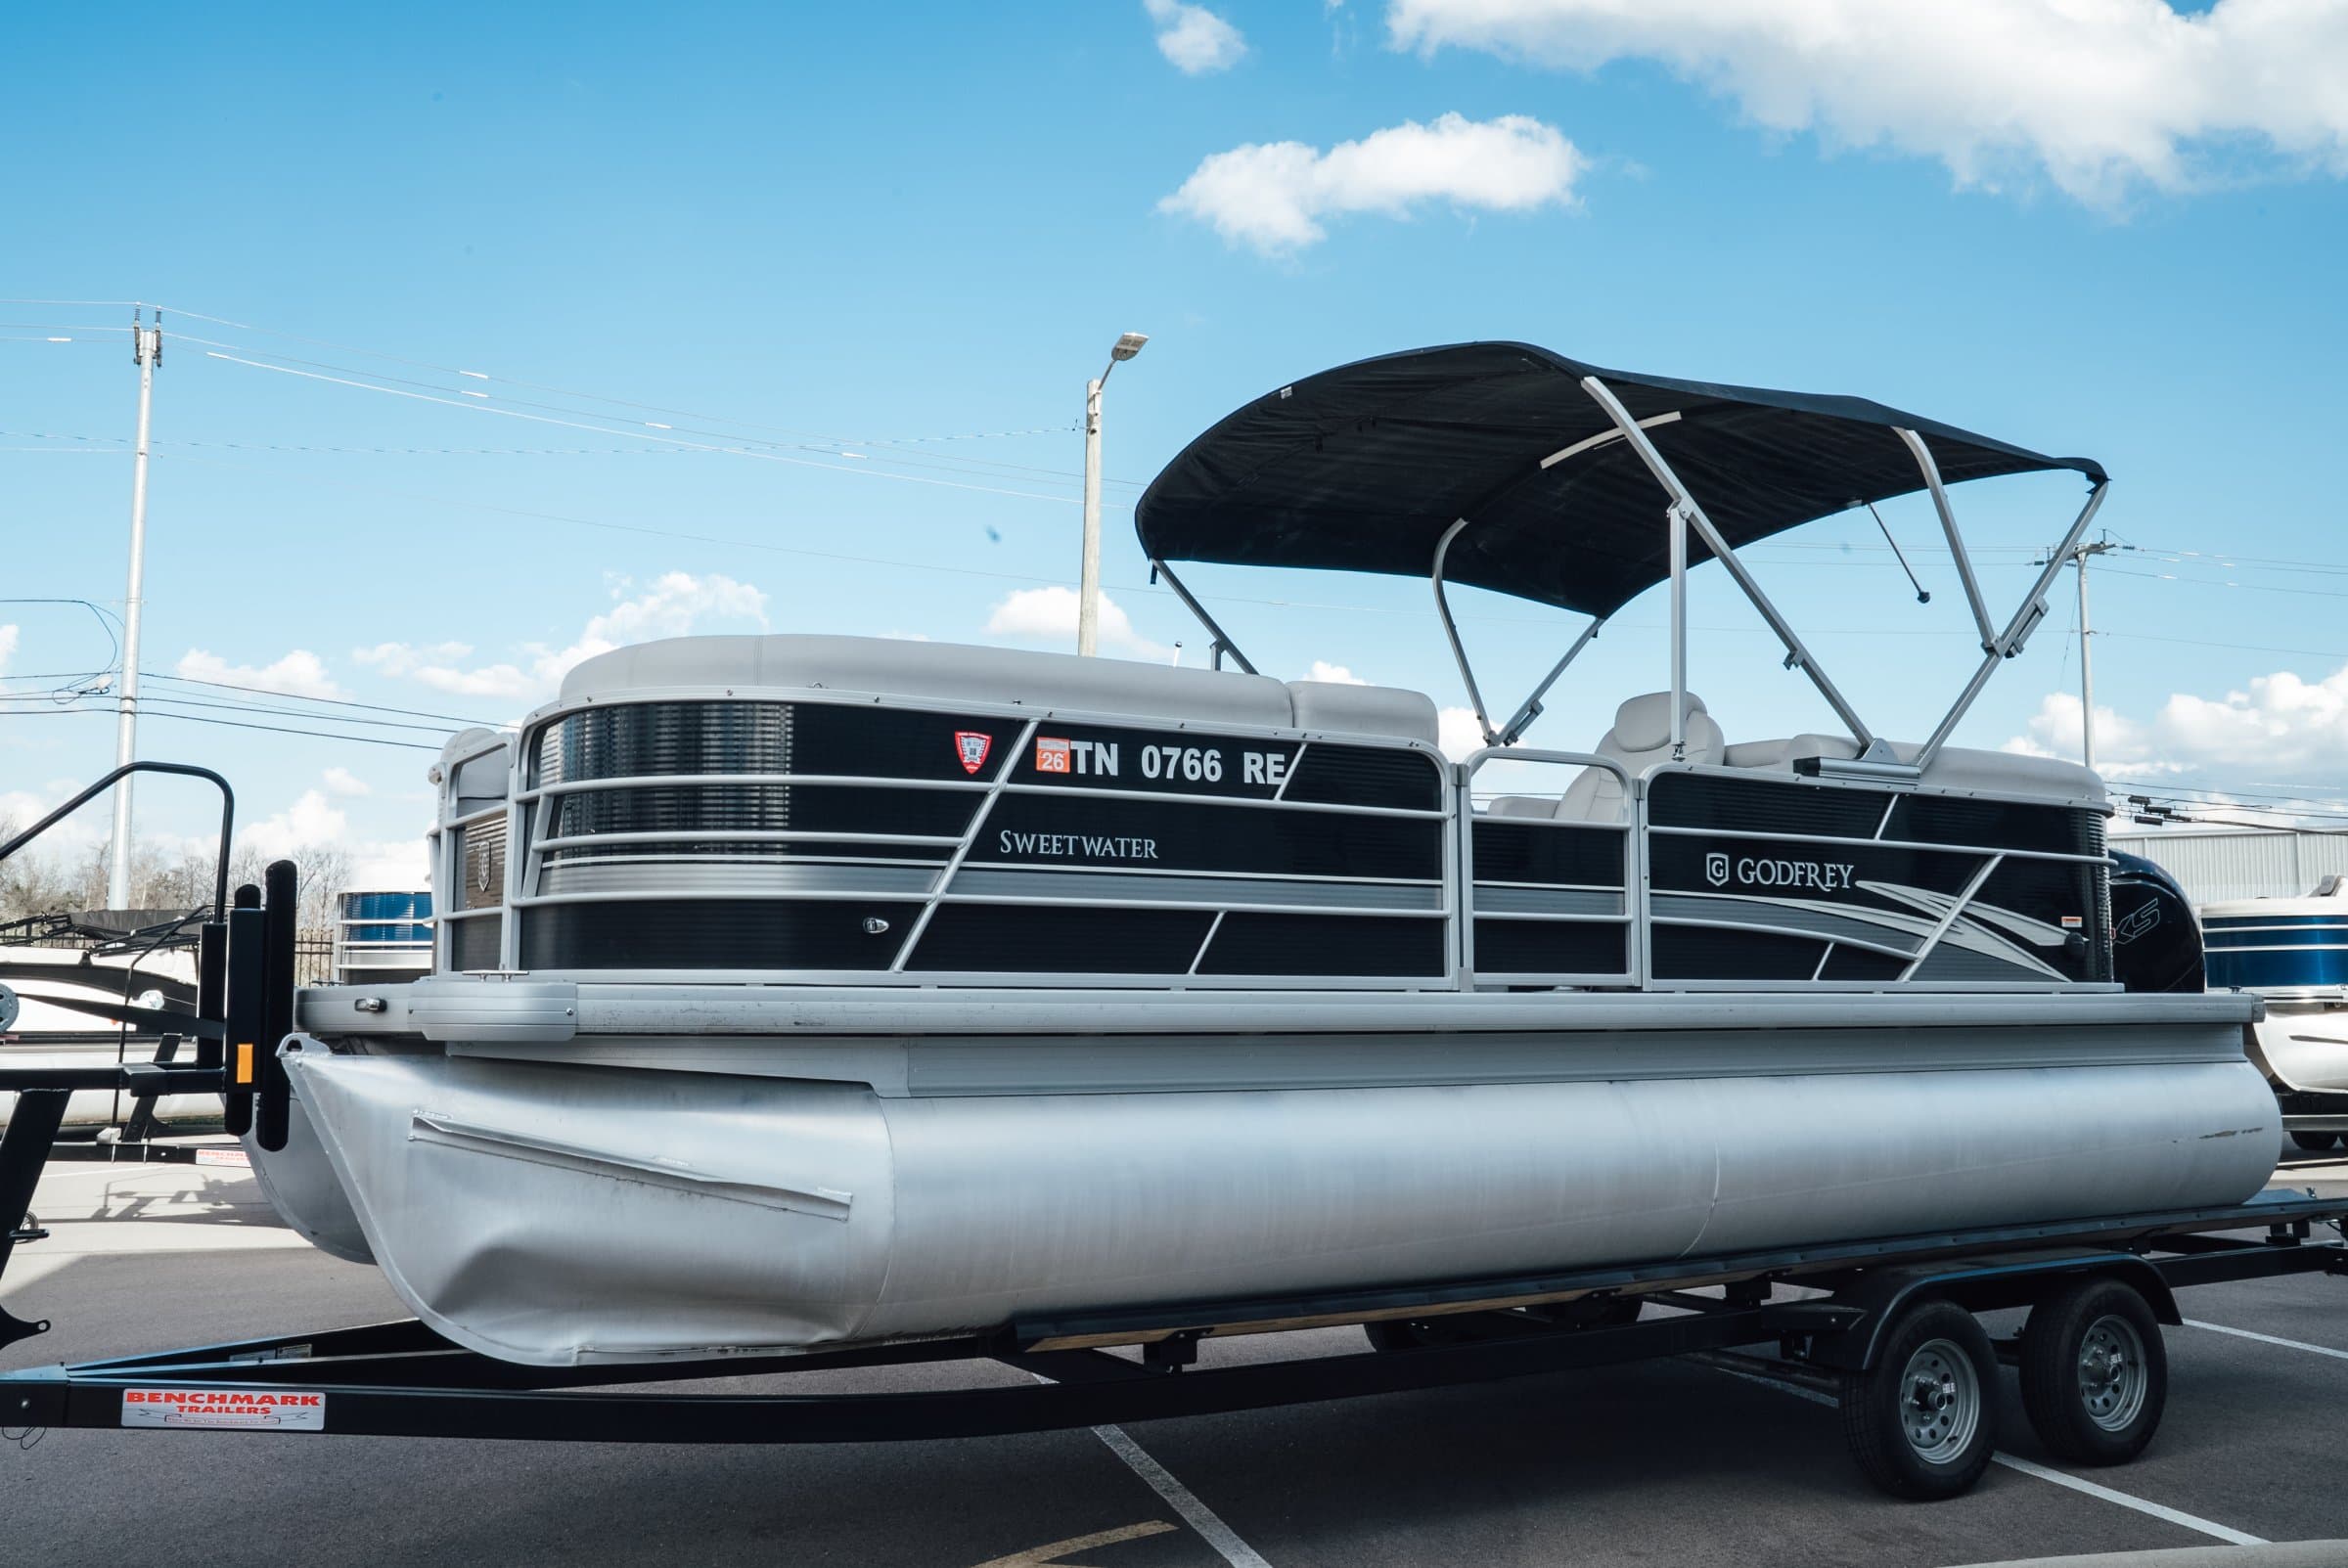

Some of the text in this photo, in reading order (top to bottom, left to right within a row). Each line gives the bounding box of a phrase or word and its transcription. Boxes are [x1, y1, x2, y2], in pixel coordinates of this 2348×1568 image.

[1040, 750, 1065, 771] 26
[1069, 740, 1286, 785] TN 0766 RE
[1000, 829, 1159, 860] SWEETWATER
[1737, 857, 1855, 892] GODFREY
[126, 1392, 321, 1407] BENCHMARK
[176, 1405, 272, 1414] TRAILERS
